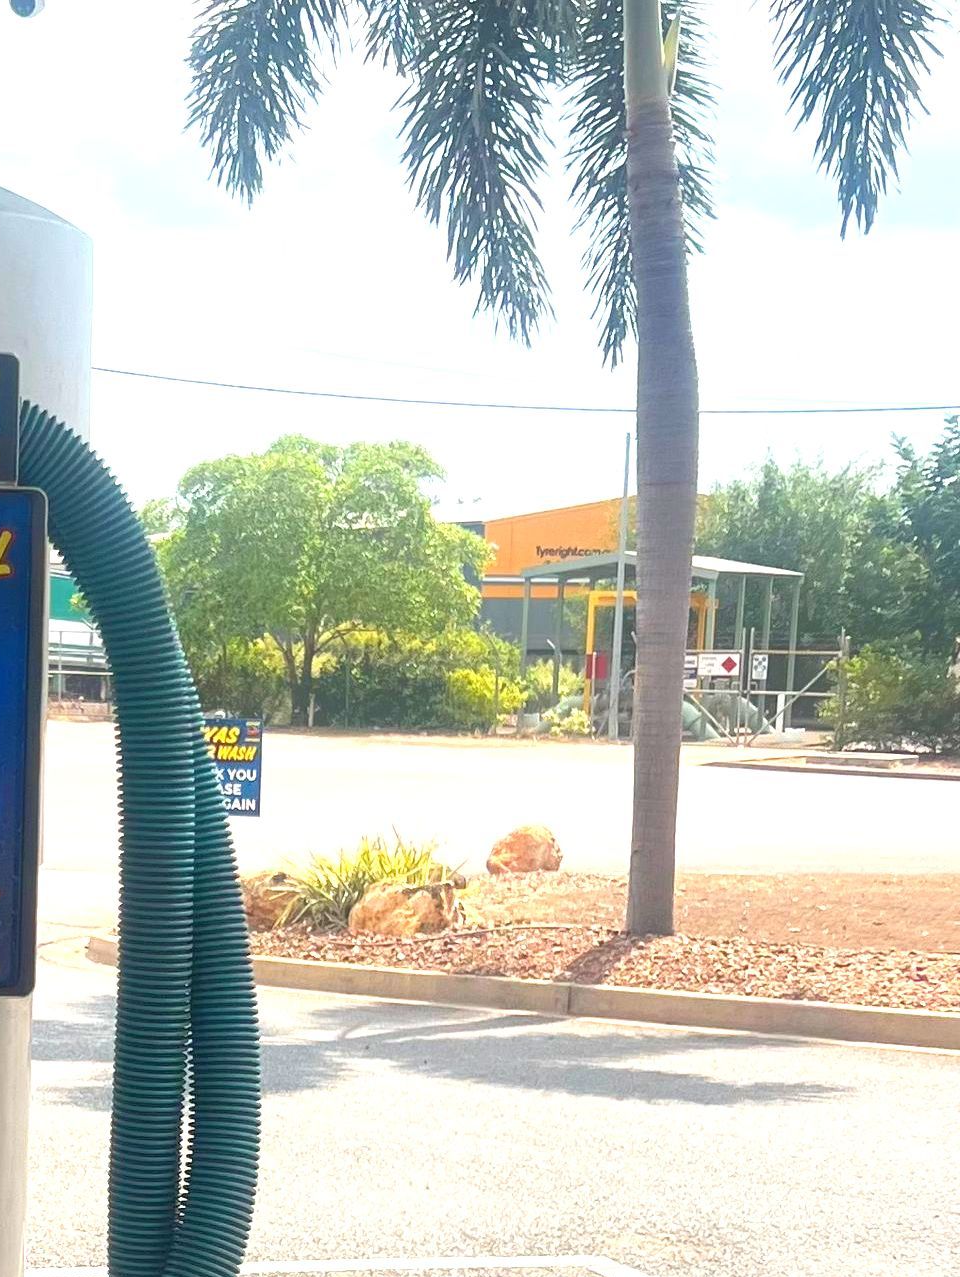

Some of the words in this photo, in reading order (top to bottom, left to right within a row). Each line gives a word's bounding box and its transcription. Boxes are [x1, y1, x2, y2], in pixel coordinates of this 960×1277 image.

[201, 726, 240, 743] YAS
[217, 745, 257, 761] WASH
[227, 769, 257, 781] YOU
[221, 798, 256, 811] GAIN
